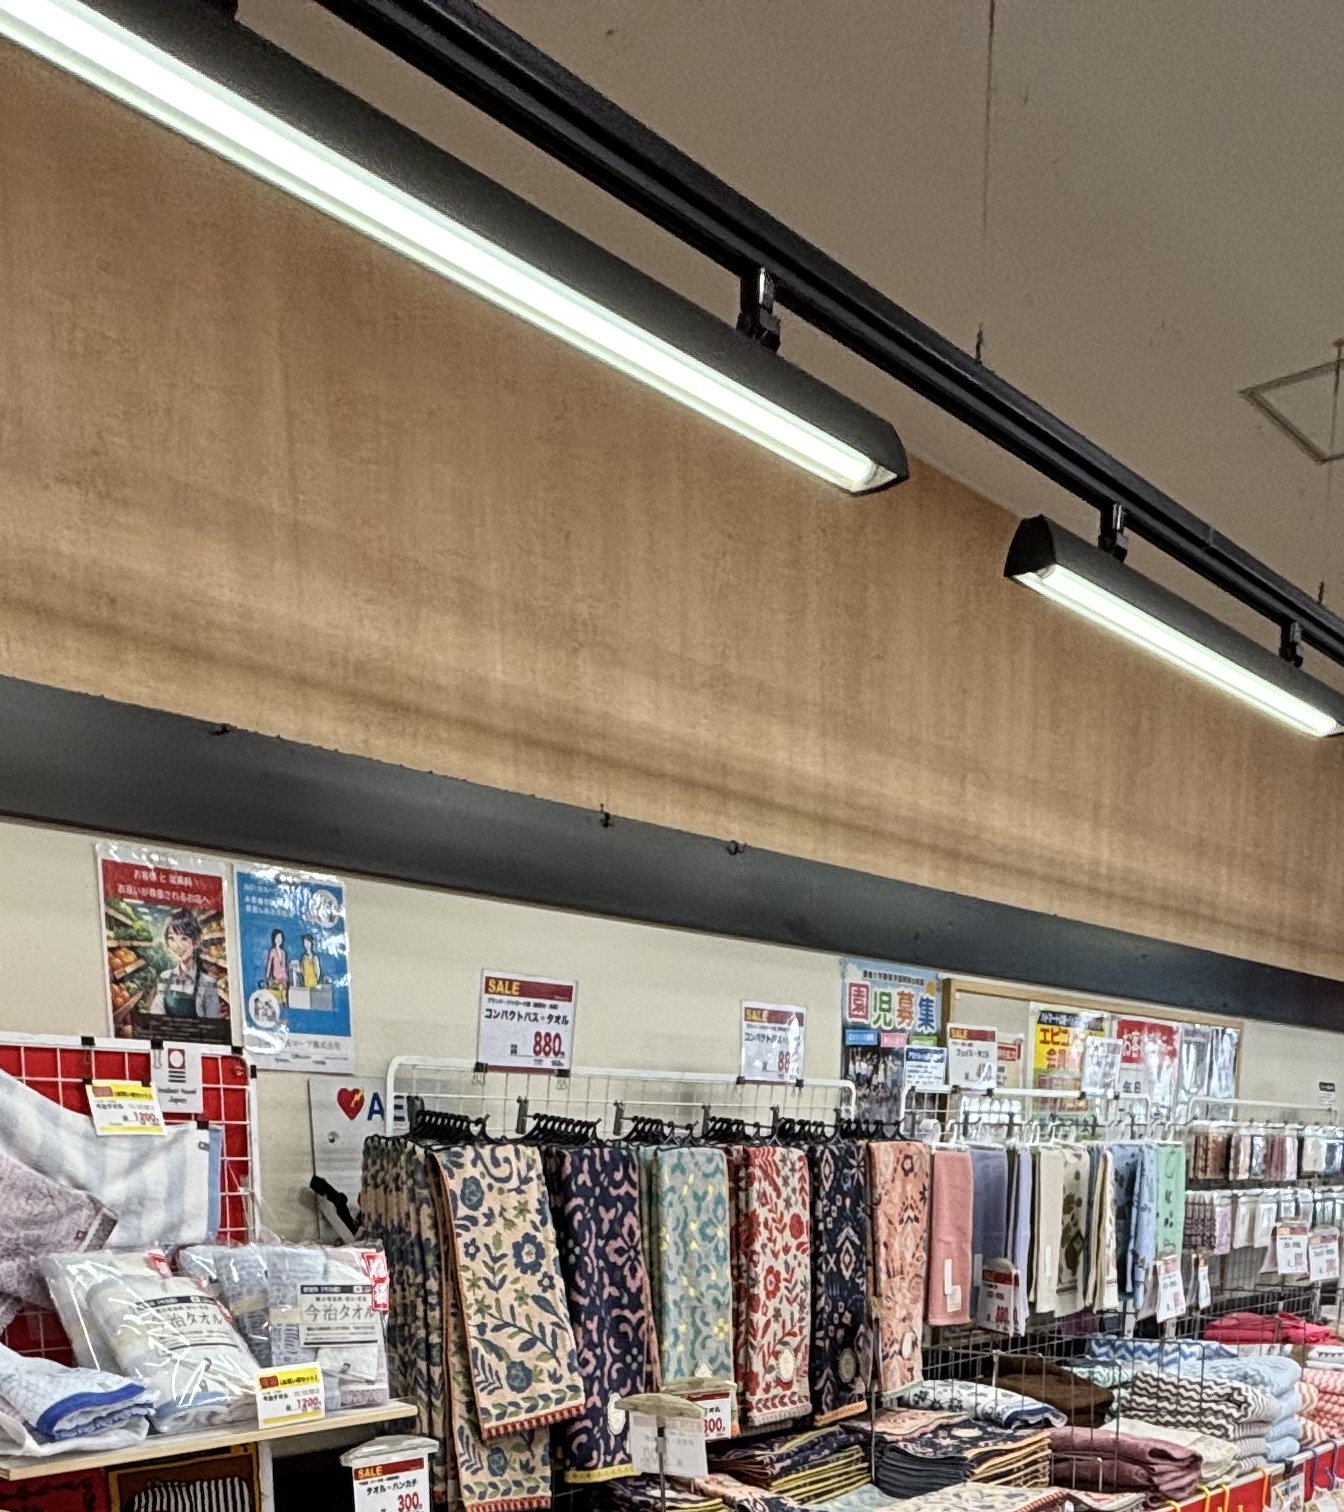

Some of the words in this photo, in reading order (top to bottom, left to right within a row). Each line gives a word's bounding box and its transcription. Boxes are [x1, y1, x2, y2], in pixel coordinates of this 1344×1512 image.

[488, 979, 521, 996] SALE
[847, 981, 937, 1031] 園児募集
[533, 1031, 562, 1057] 880
[304, 1303, 375, 1322] 今治タオル
[357, 1465, 383, 1479] SALE
